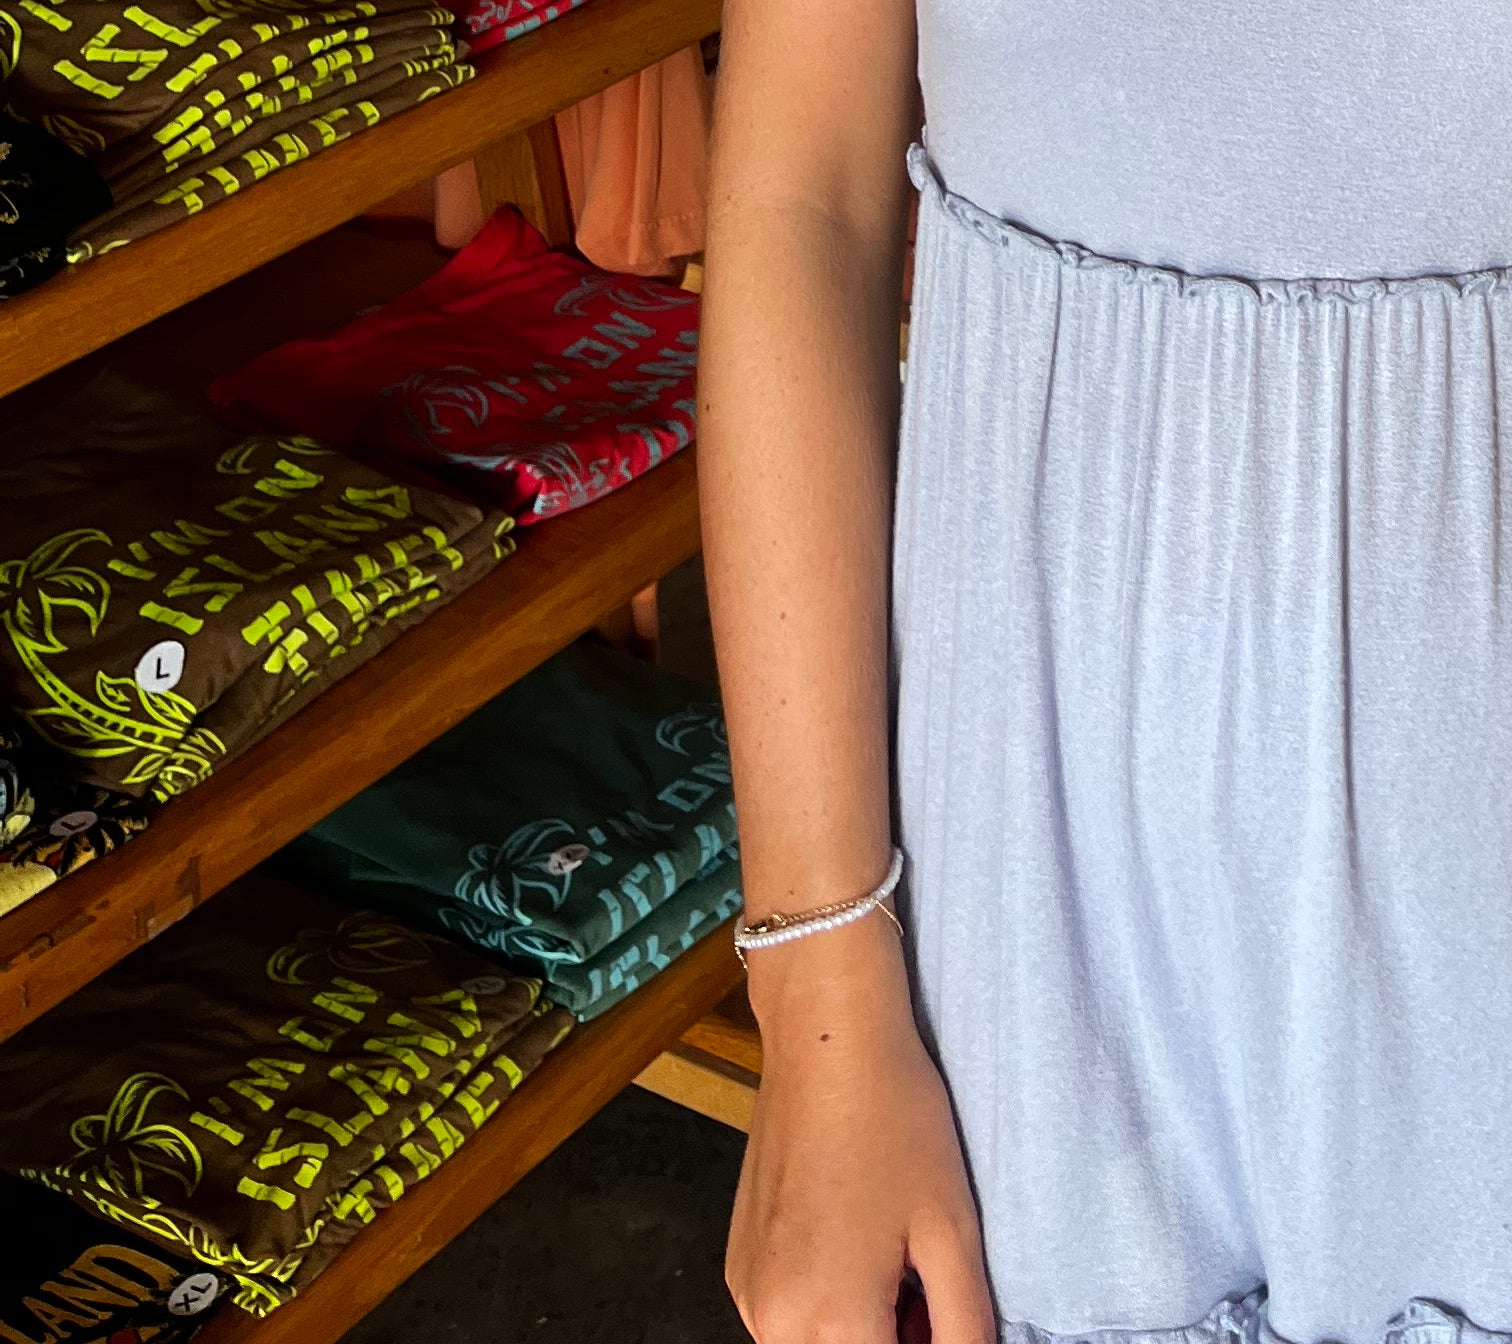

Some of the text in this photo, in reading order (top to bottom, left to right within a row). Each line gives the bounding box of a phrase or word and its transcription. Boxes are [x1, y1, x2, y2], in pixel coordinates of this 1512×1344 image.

[107, 459, 324, 581] I'M ON
[155, 656, 170, 680] L
[189, 976, 384, 1146] I'M ON
[173, 1281, 213, 1312] XL
